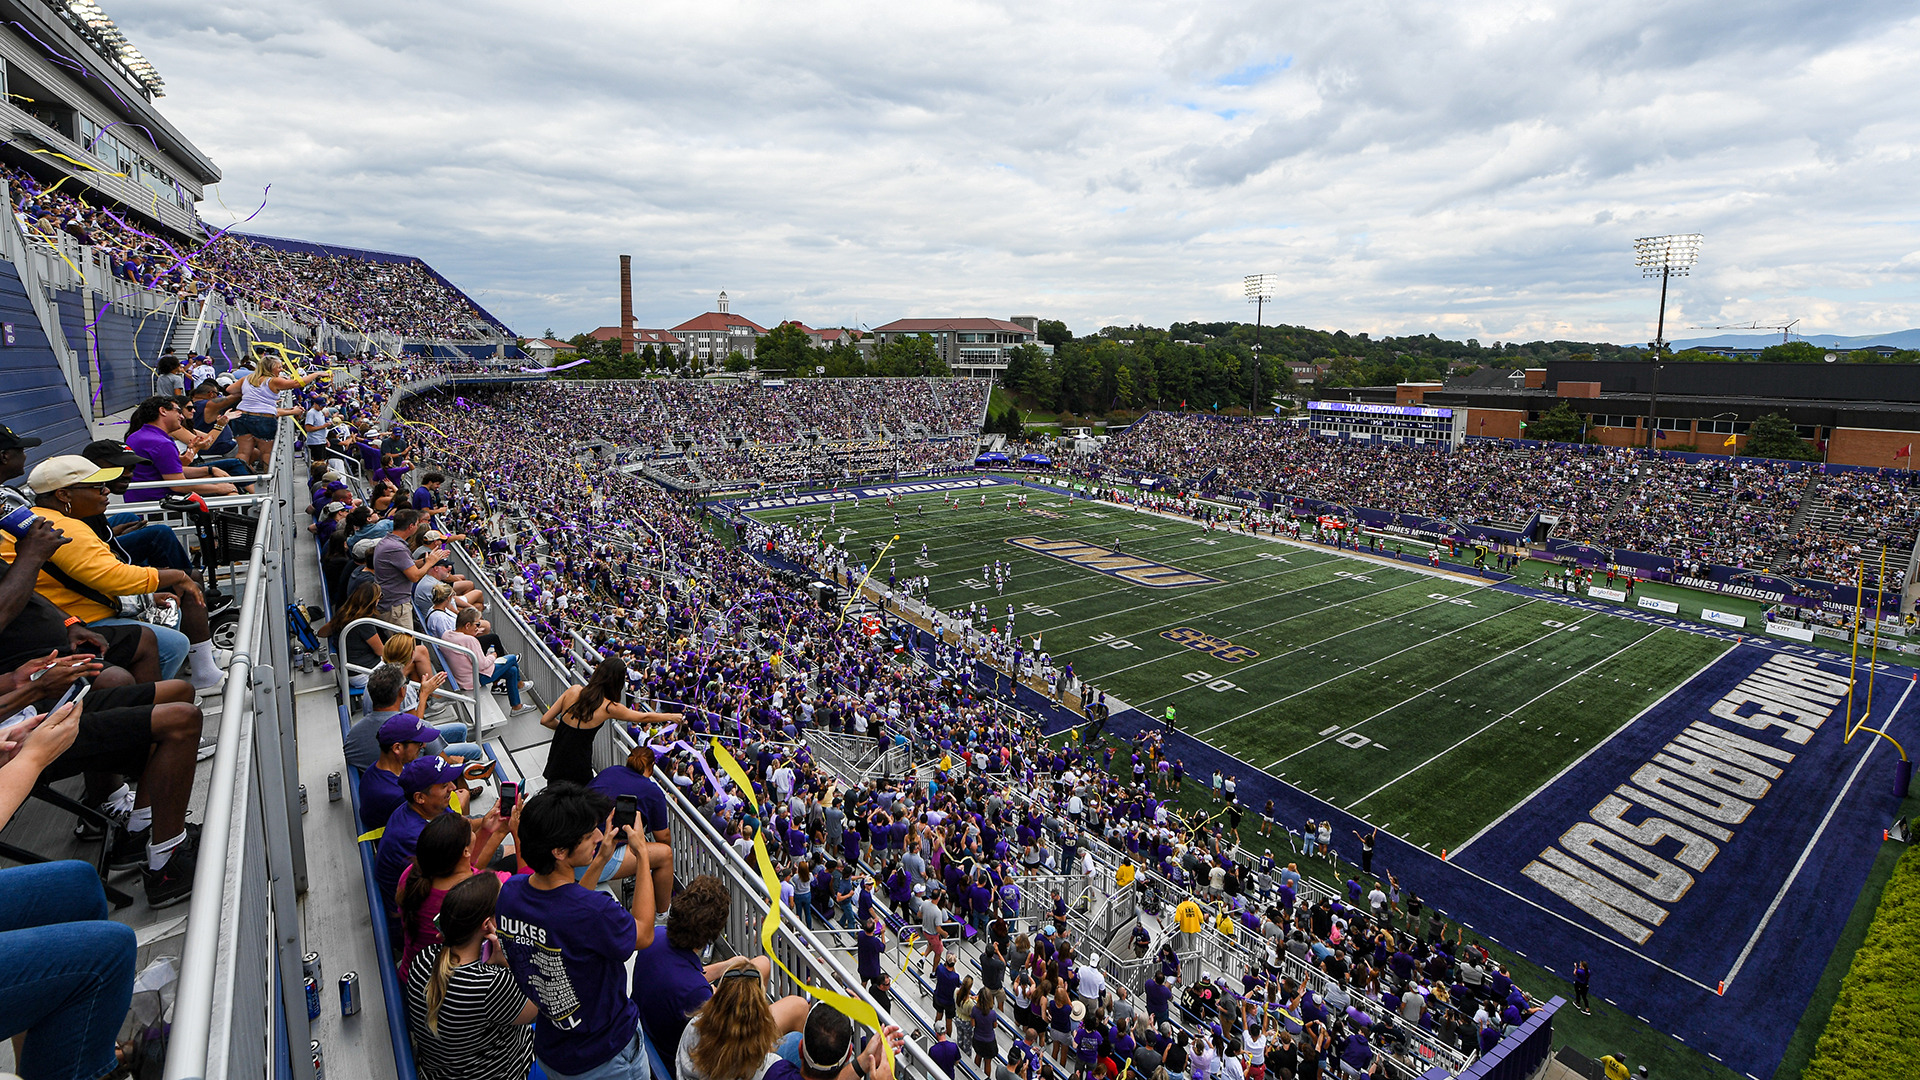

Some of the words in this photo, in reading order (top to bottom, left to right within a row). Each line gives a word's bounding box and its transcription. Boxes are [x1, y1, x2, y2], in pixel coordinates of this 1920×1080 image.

[1345, 403, 1404, 414] TOUCHDOWN
[740, 493, 858, 509] JAMES
[863, 479, 999, 497] MADISON
[1383, 524, 1412, 535] JAMES
[1004, 535, 1229, 589] JMU
[1621, 565, 1637, 574] BELT
[958, 578, 991, 590] 50
[1676, 576, 1719, 590] JAMES
[1721, 583, 1785, 602] MADISON
[1021, 602, 1055, 616] 40
[1822, 601, 1841, 611] SUN
[1614, 609, 1772, 645] SHOWKER
[1769, 624, 1790, 632] SCOTT
[1818, 628, 1840, 637] JMU
[1089, 631, 1134, 650] 30
[1159, 627, 1260, 663] SBC
[1182, 670, 1237, 693] 20
[1708, 653, 1858, 745] JAMES
[1318, 725, 1372, 749] 10
[1520, 719, 1796, 945] MADISON
[500, 915, 547, 944] DUKES
[515, 935, 535, 947] 2024
